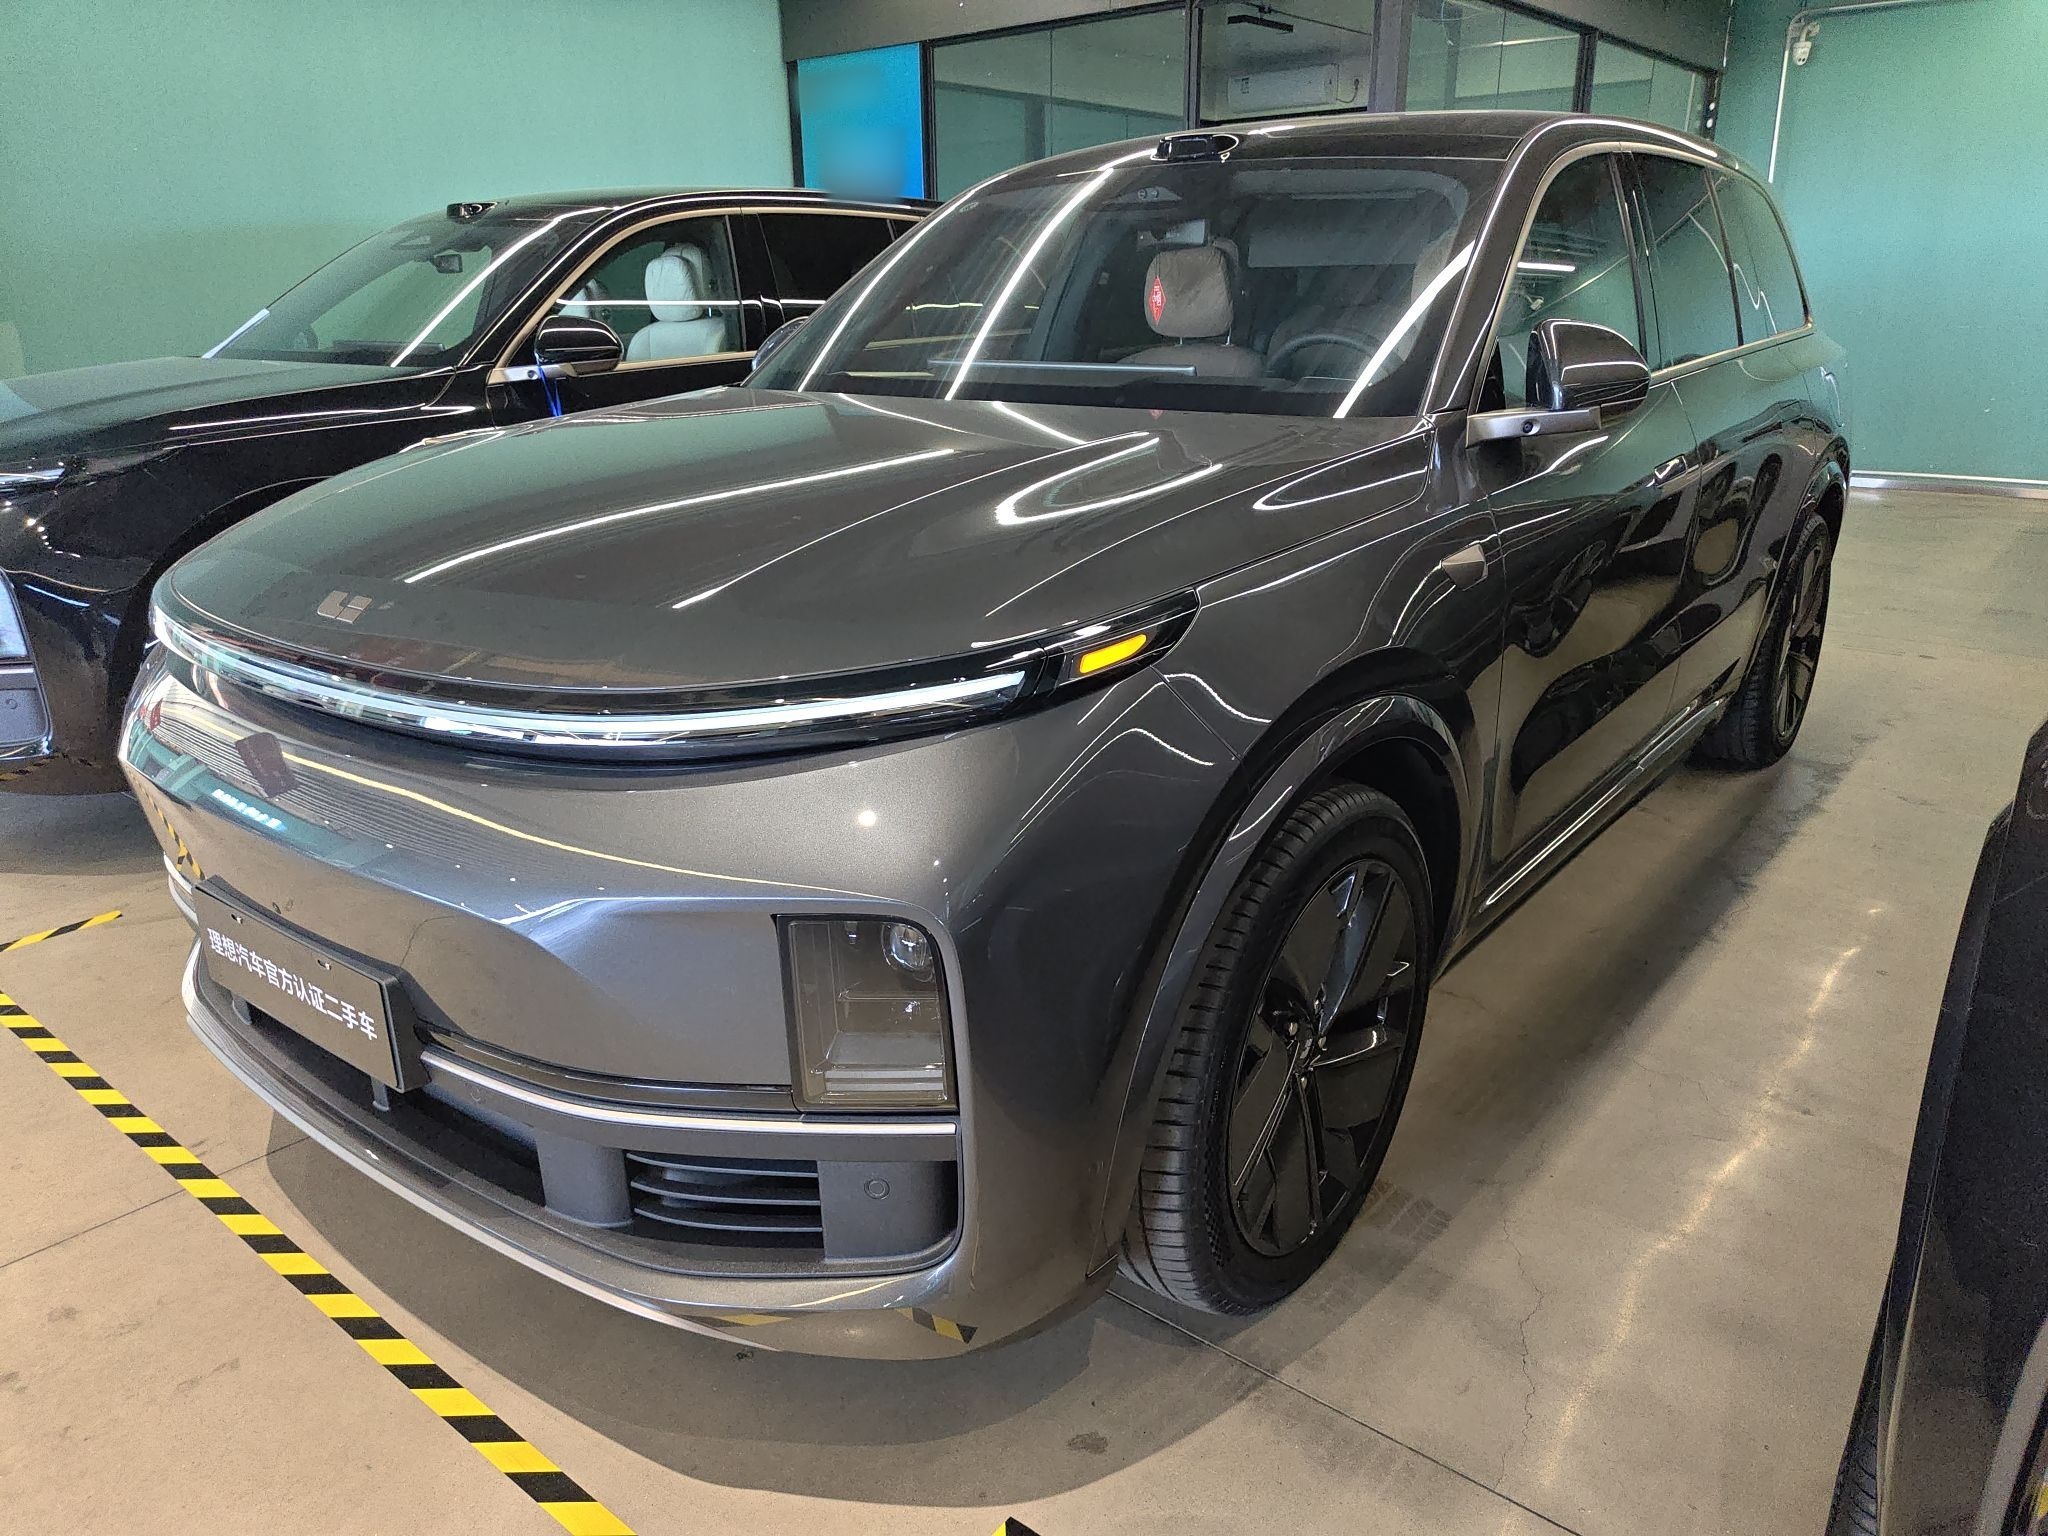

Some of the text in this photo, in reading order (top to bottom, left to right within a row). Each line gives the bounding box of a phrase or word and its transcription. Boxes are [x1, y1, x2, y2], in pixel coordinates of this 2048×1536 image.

[206, 928, 378, 1041] 理想汽车官方认证二手车
